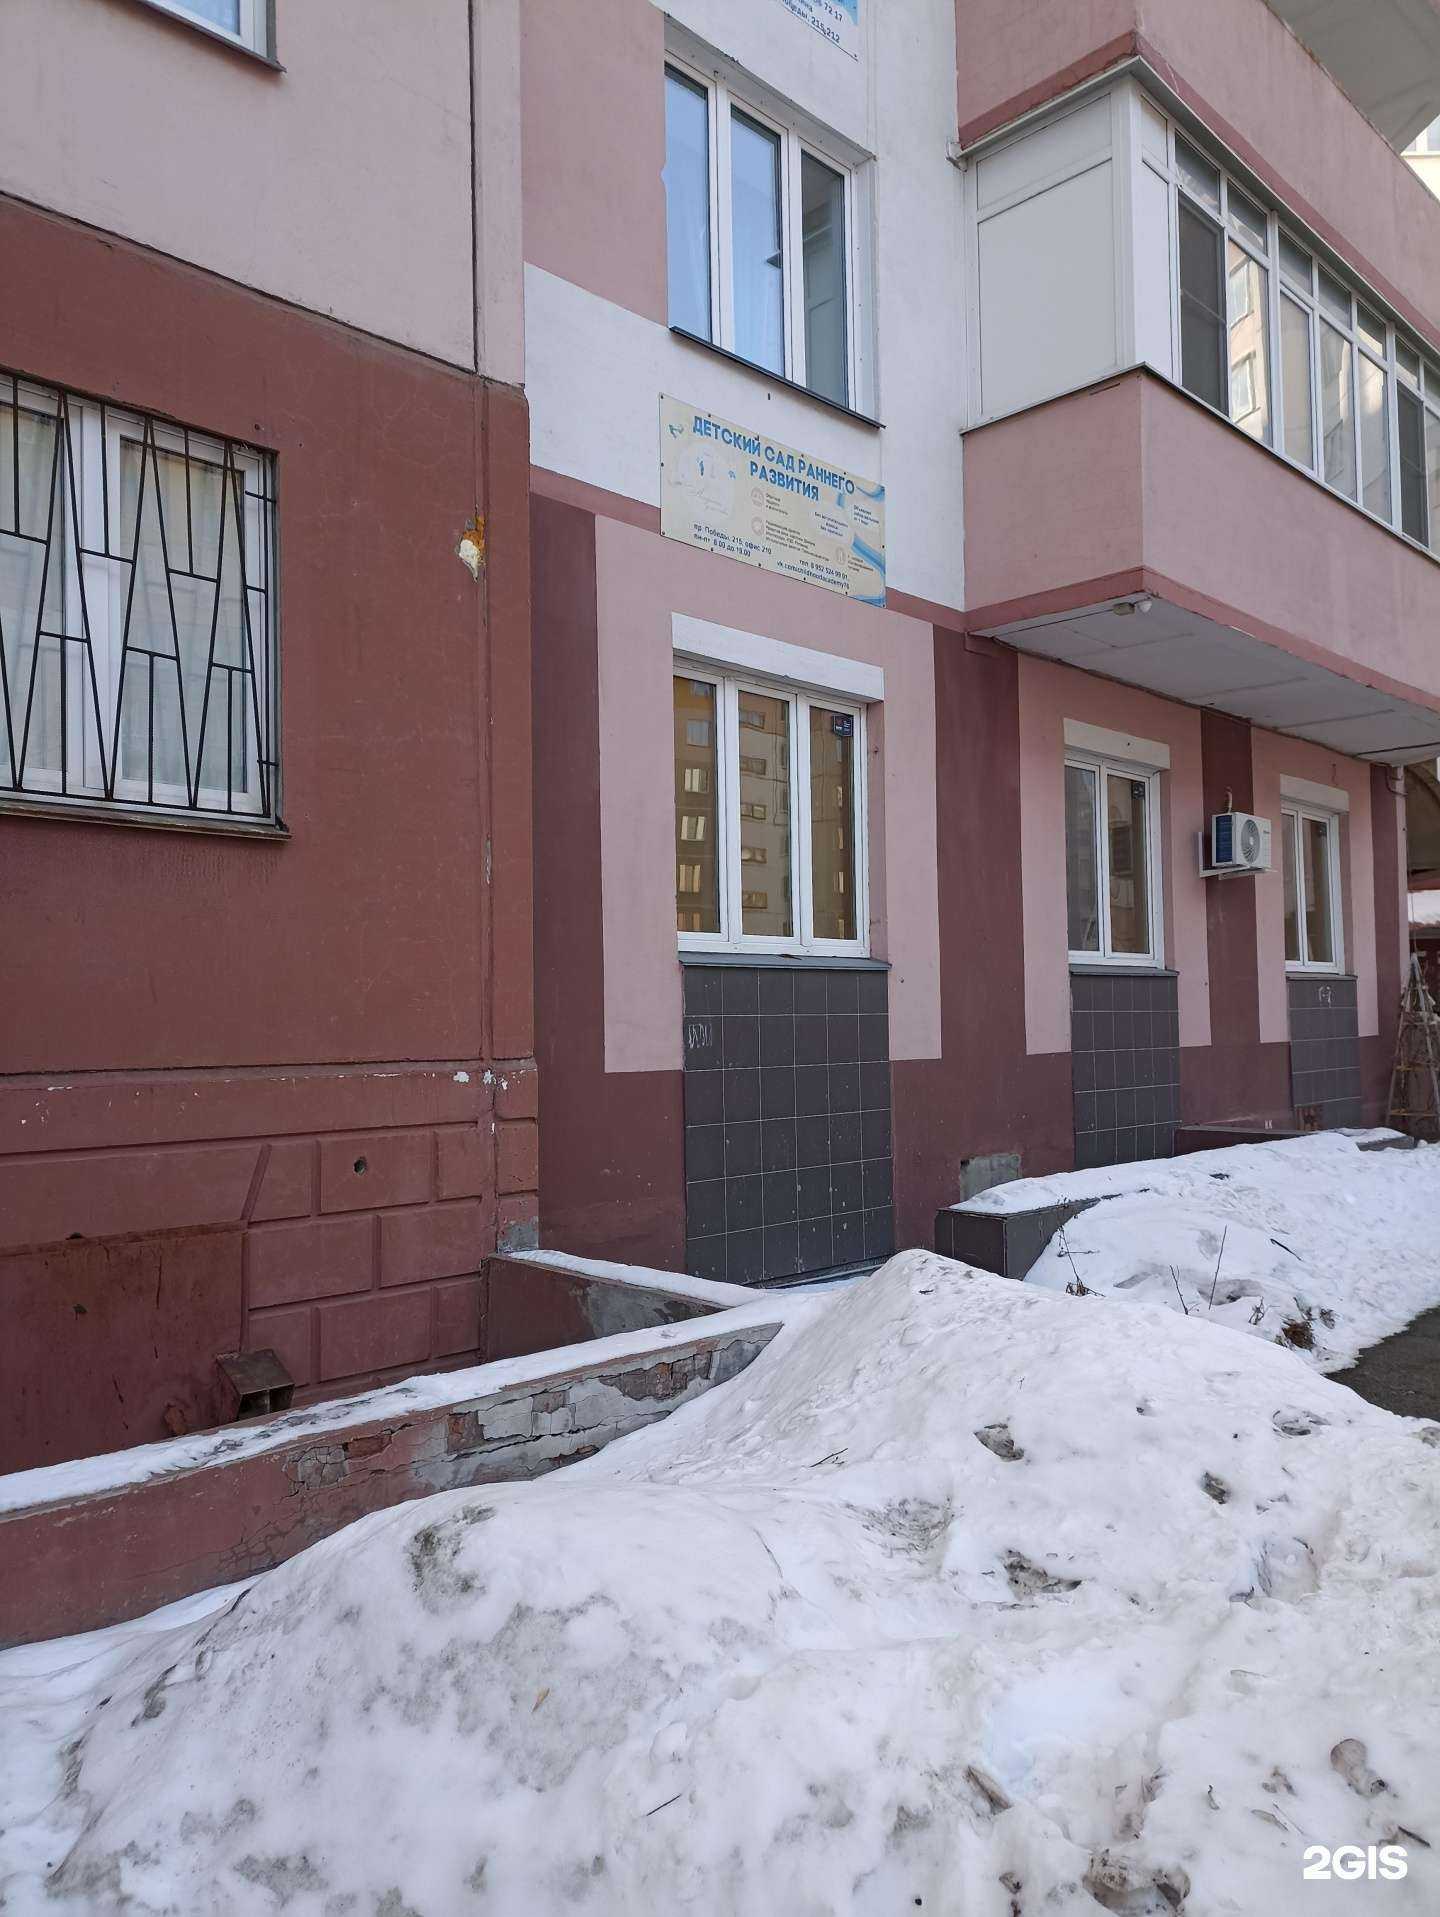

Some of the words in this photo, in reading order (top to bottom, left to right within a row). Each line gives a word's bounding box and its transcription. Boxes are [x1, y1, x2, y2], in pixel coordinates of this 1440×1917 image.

[692, 415, 761, 457] ДЕТСКИЙ
[764, 446, 795, 472] САД
[798, 458, 855, 495] РАННЕГО
[750, 461, 819, 501] РАЗВИТИЯ
